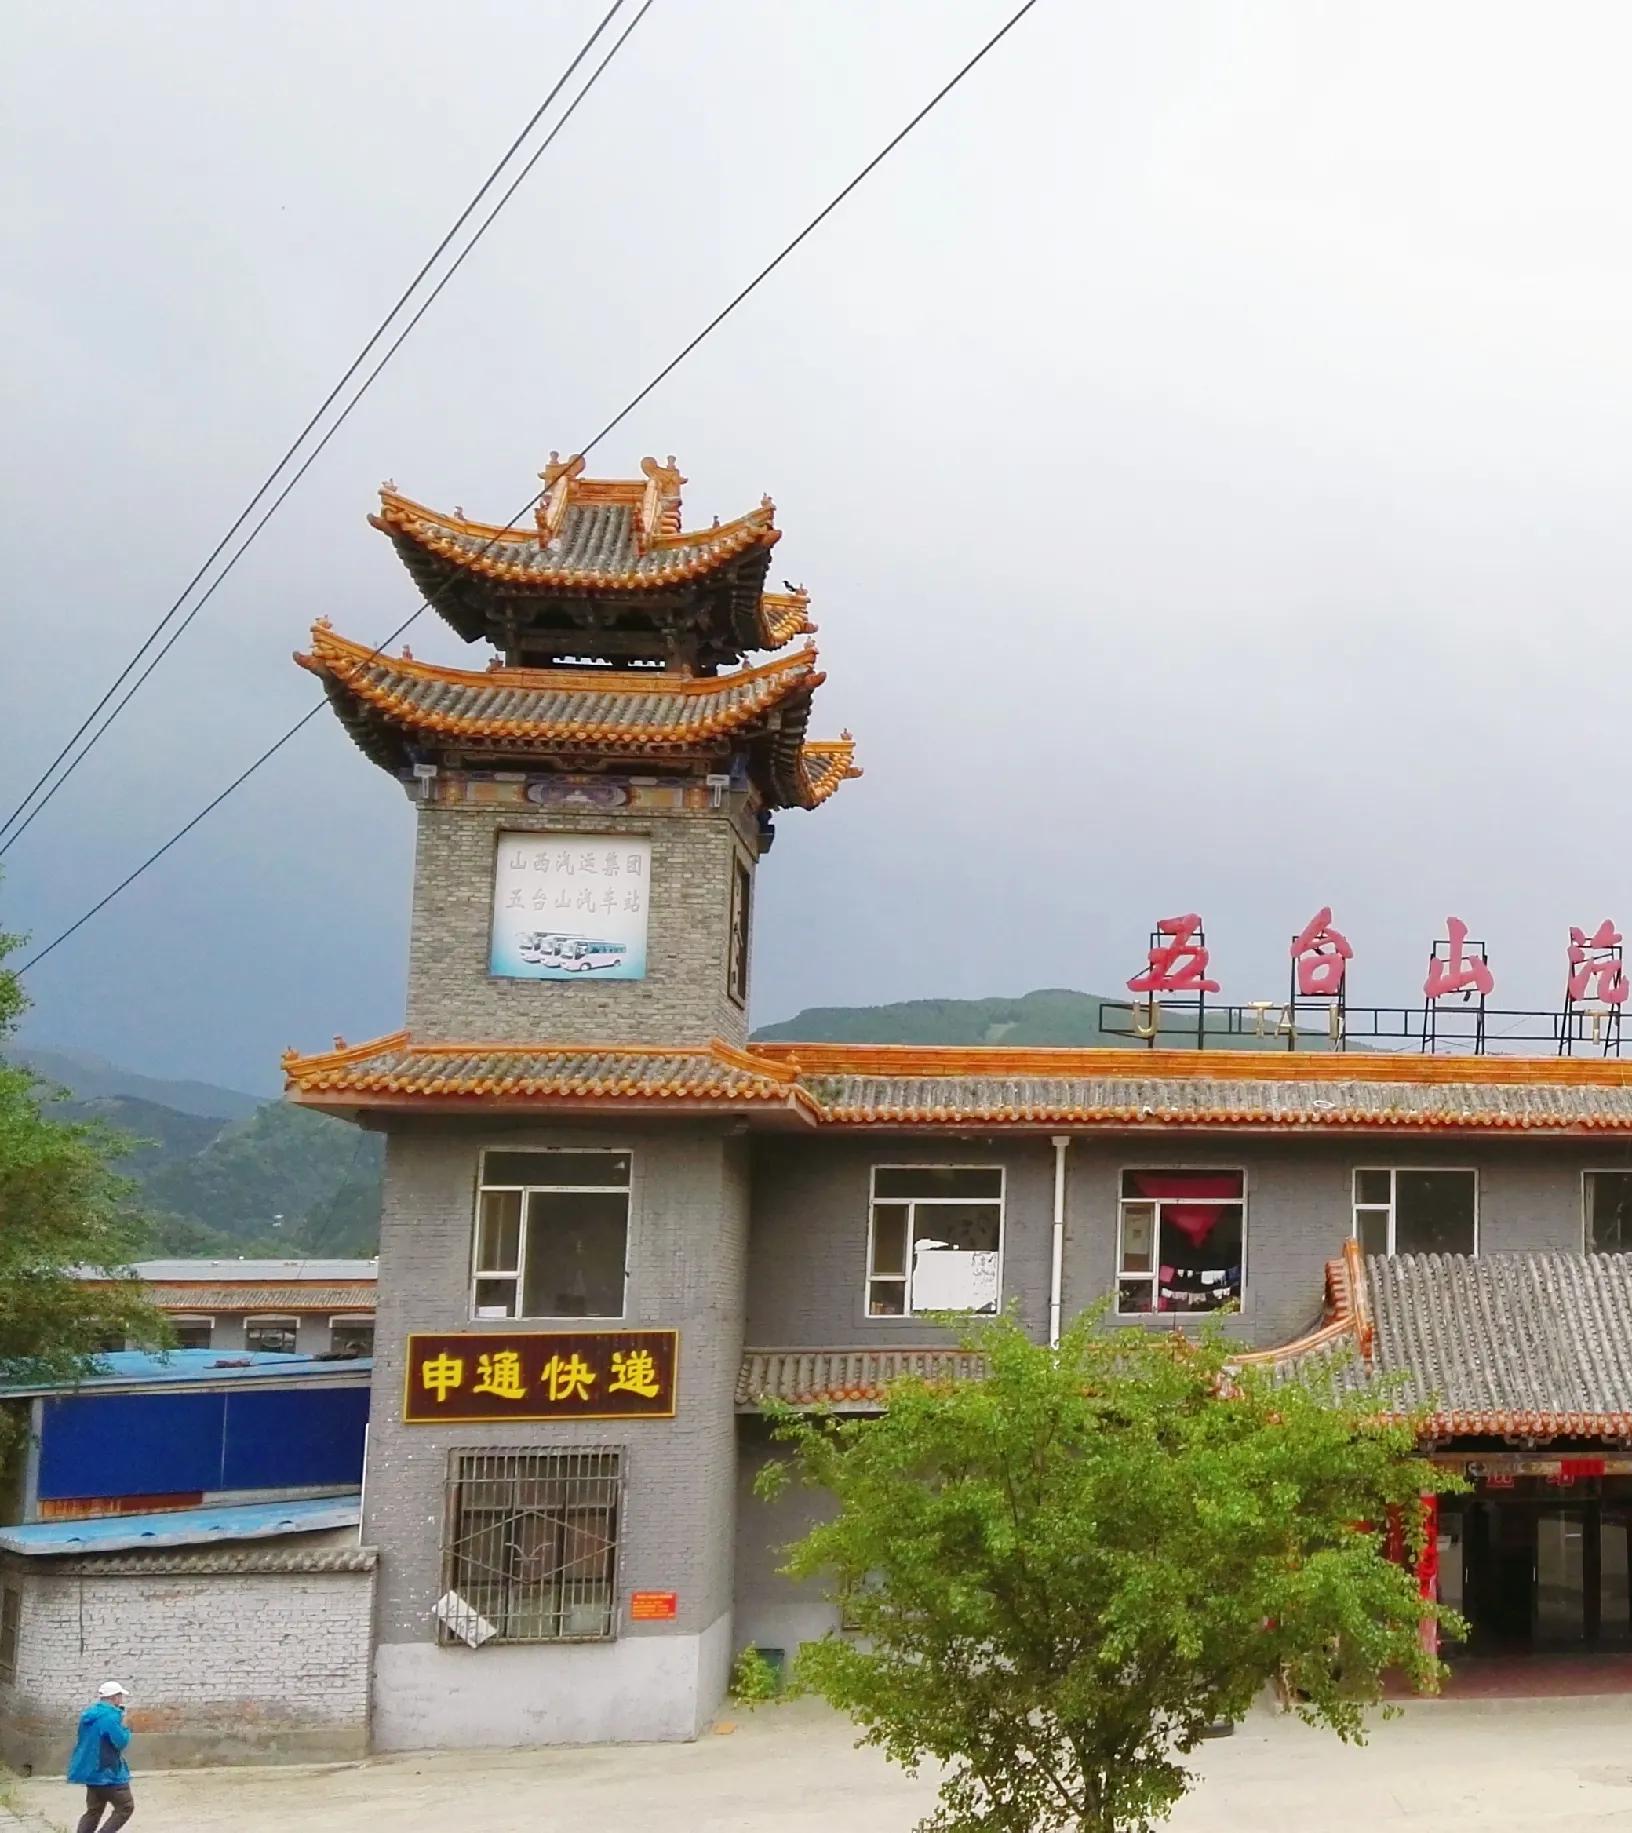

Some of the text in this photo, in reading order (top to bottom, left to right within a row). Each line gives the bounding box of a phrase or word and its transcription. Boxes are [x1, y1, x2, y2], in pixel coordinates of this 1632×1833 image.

[510, 850, 642, 876] 山西汽运集团
[505, 886, 642, 916] 五台山汽车站
[421, 1348, 660, 1403] 申通快递
